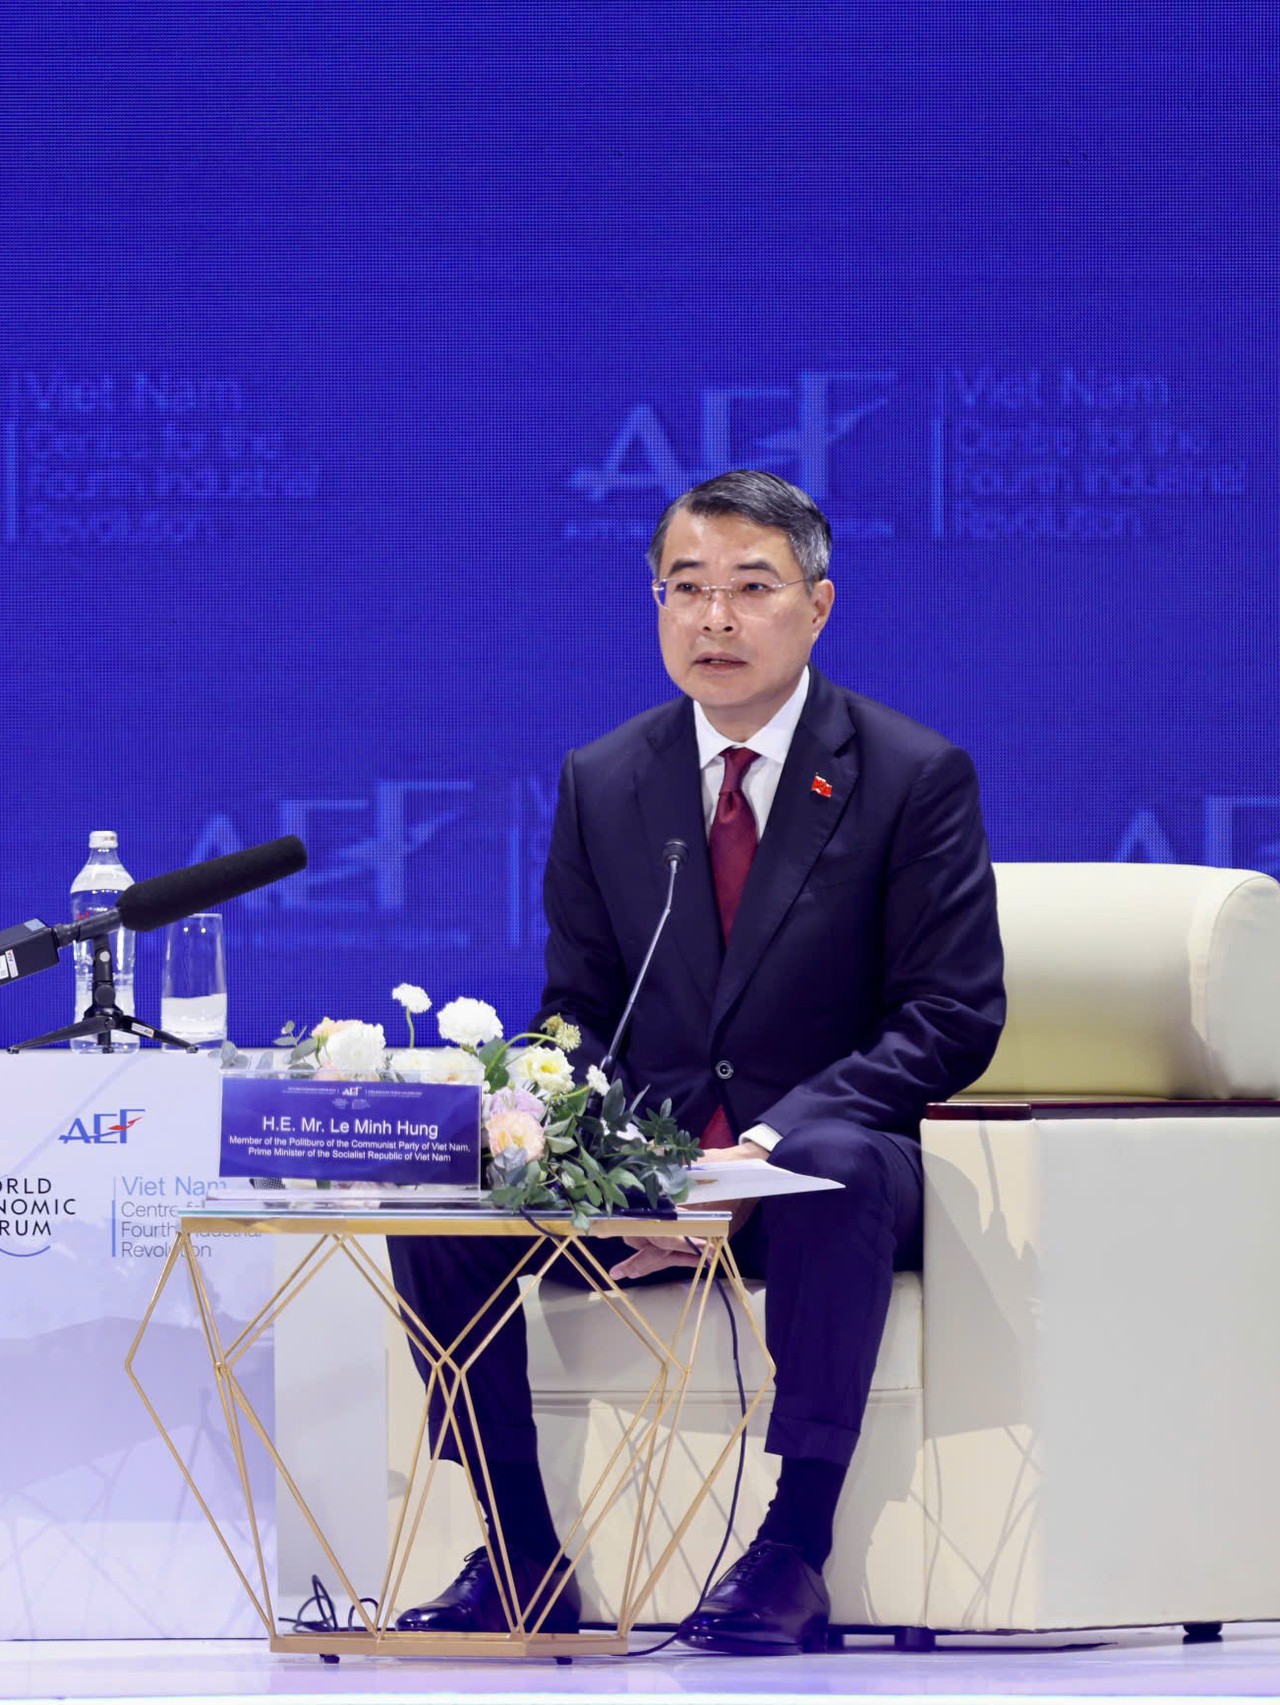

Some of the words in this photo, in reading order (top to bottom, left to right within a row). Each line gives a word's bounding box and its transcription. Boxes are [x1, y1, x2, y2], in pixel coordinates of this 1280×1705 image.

[133, 371, 243, 412] Nam
[953, 368, 1042, 409] Viet
[1060, 368, 1169, 408] Nam
[568, 370, 898, 502] AEF
[58, 1109, 146, 1144] AEF
[263, 1116, 296, 1132] H.E.
[301, 1117, 325, 1133] Mr.
[331, 1118, 350, 1134] Le
[355, 1119, 392, 1135] Minh
[397, 1120, 439, 1139] Hung
[229, 1135, 263, 1145] Member
[264, 1136, 273, 1145] of
[274, 1136, 287, 1146] the
[289, 1137, 325, 1147] Politburo
[326, 1138, 336, 1148] of
[337, 1139, 350, 1148] the
[351, 1139, 397, 1149] Communist
[398, 1140, 419, 1152] Party
[421, 1141, 430, 1151] of
[431, 1142, 447, 1151] Viet
[248, 1146, 272, 1157] Prime
[273, 1147, 305, 1157] Minister
[307, 1148, 316, 1158] of
[317, 1148, 330, 1158] the
[332, 1149, 366, 1159] Socialist
[368, 1151, 403, 1161] Republic
[404, 1151, 413, 1161] of
[414, 1152, 430, 1162] Viet
[432, 1152, 451, 1162] Nam
[121, 1176, 166, 1196] Viet
